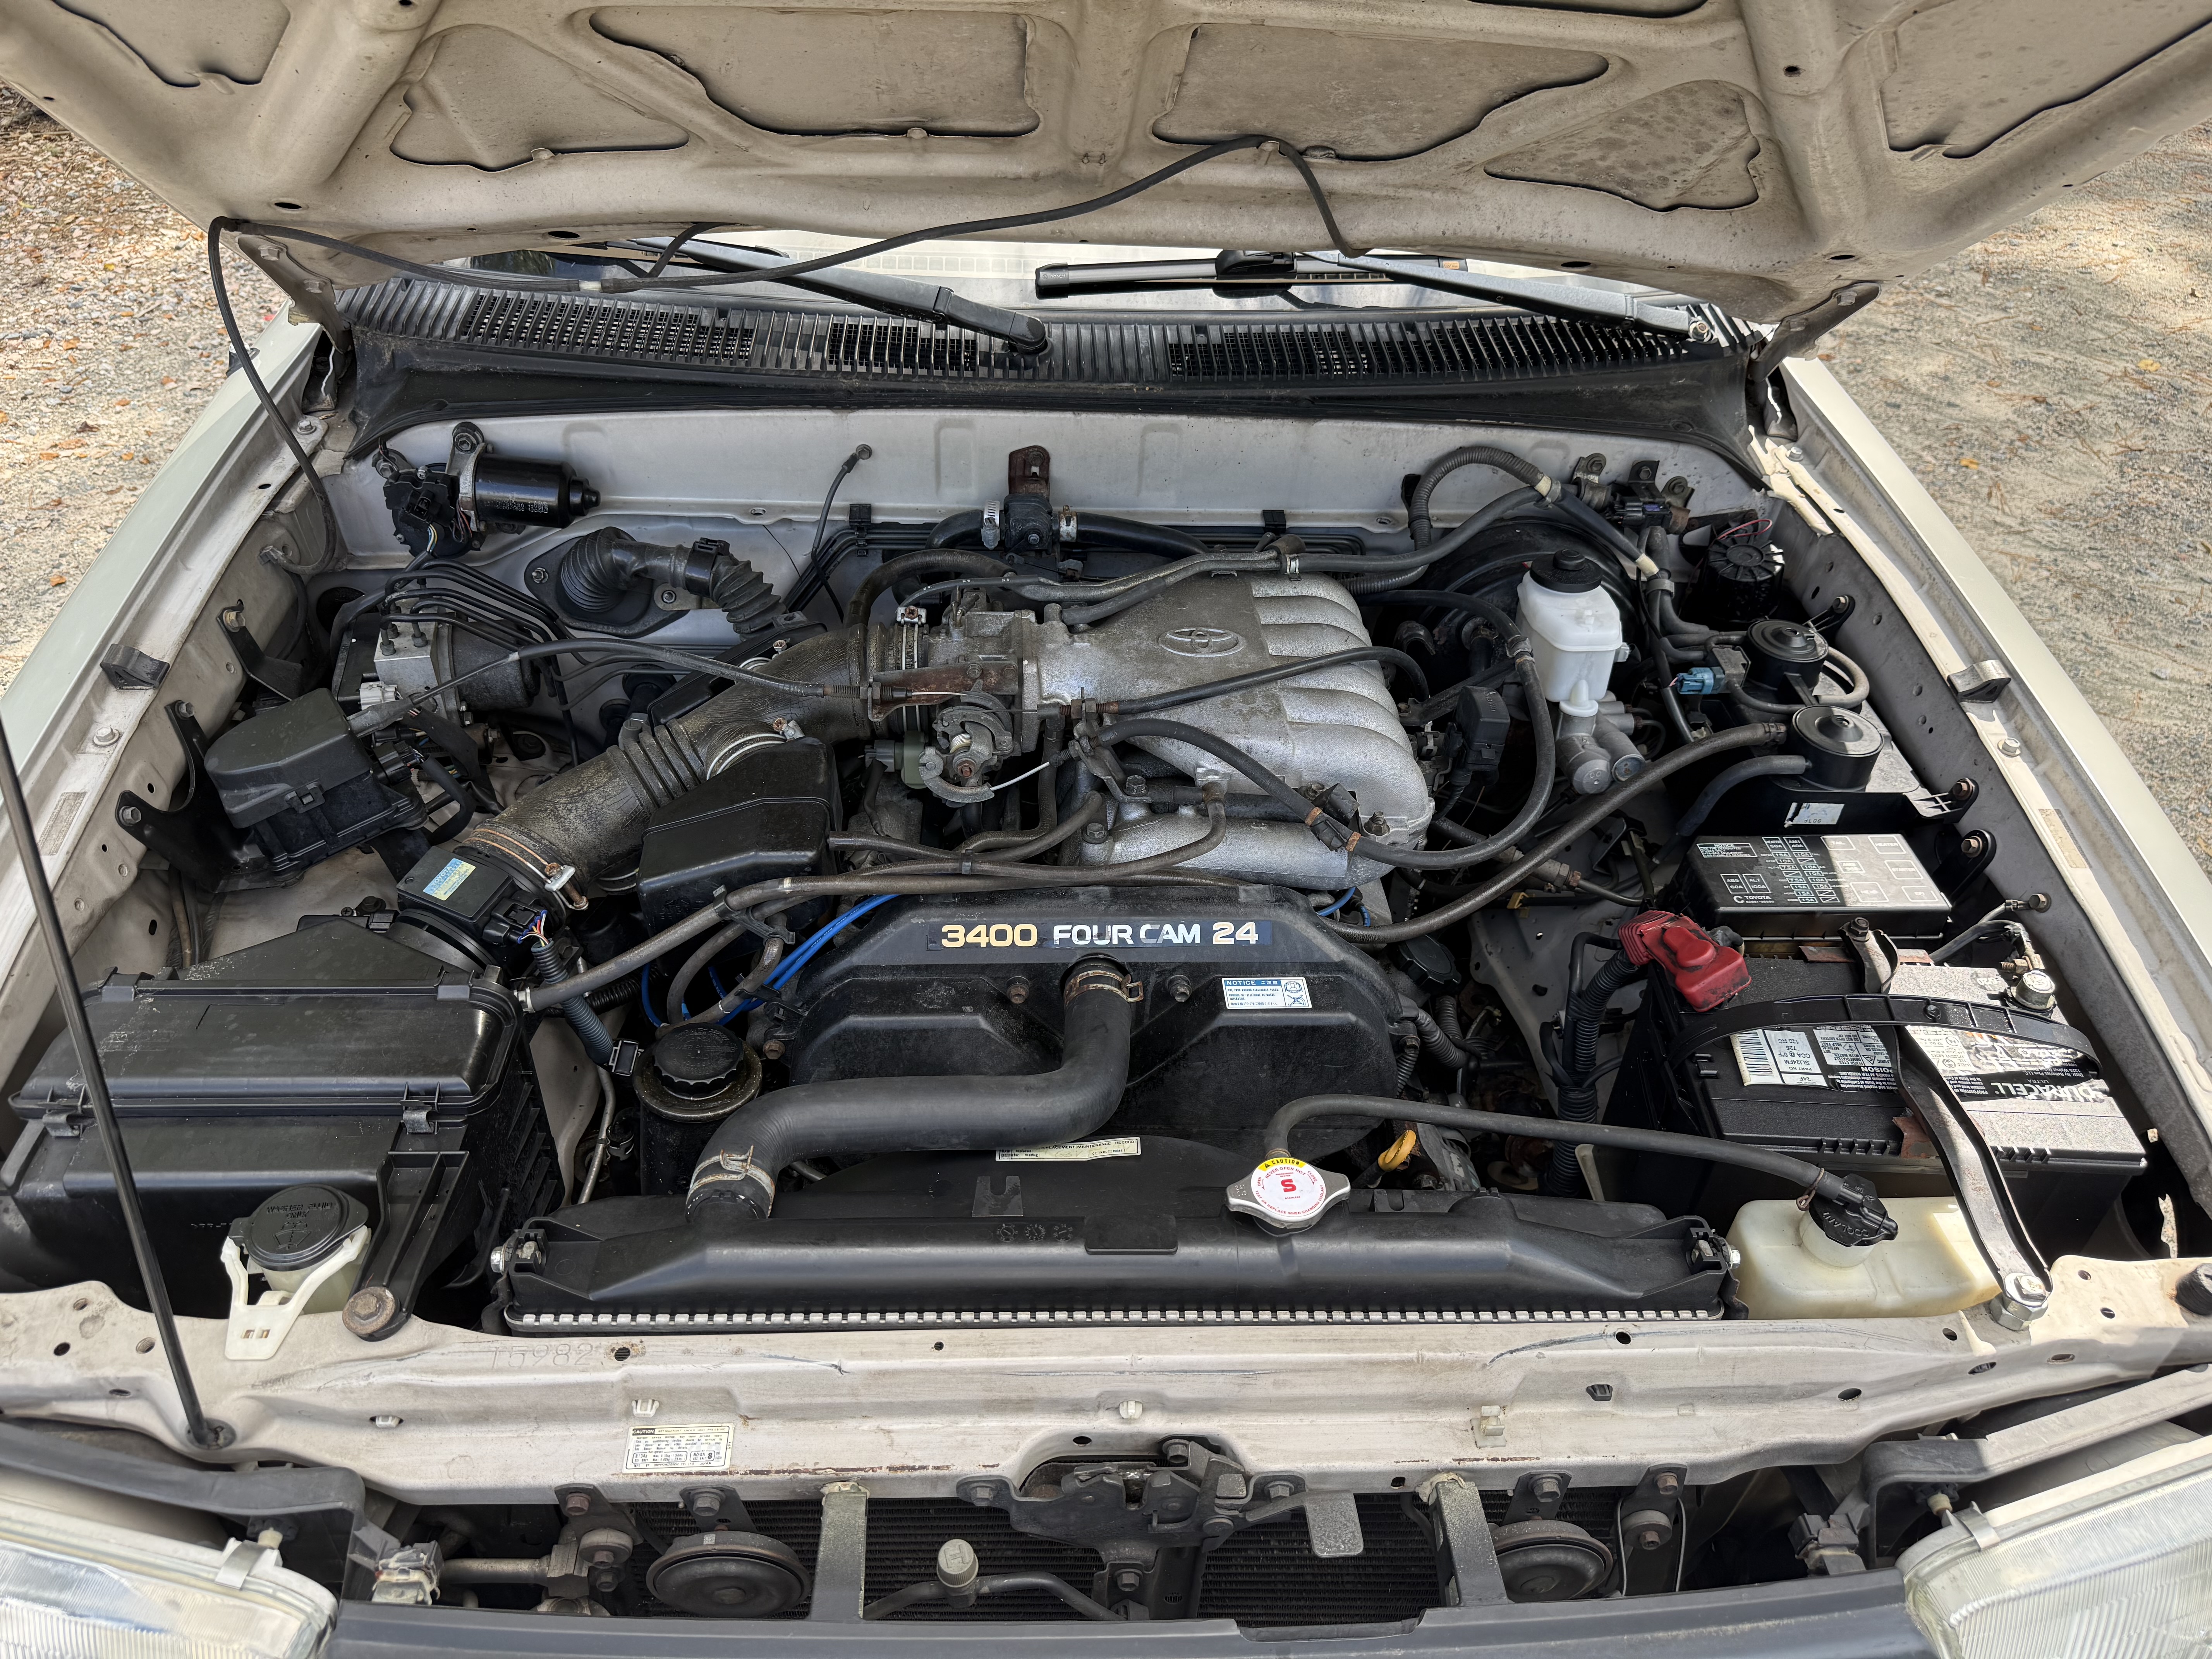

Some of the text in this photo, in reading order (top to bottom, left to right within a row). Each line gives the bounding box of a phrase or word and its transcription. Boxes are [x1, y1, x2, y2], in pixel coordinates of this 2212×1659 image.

[430, 865, 452, 887] TOYOTA
[941, 921, 1259, 947] 3400 FOUR CAM 24
[1990, 1082, 2096, 1099] DURACELL
[1265, 1168, 1279, 1179] NEVER
[1308, 1171, 1317, 1181] CLOSE
[1281, 1179, 1297, 1192] S
[267, 1204, 303, 1214] WASHER
[286, 1209, 309, 1219] ONLY
[1267, 1204, 1286, 1214] REPLACE
[1302, 1201, 1320, 1213] CHANGING
